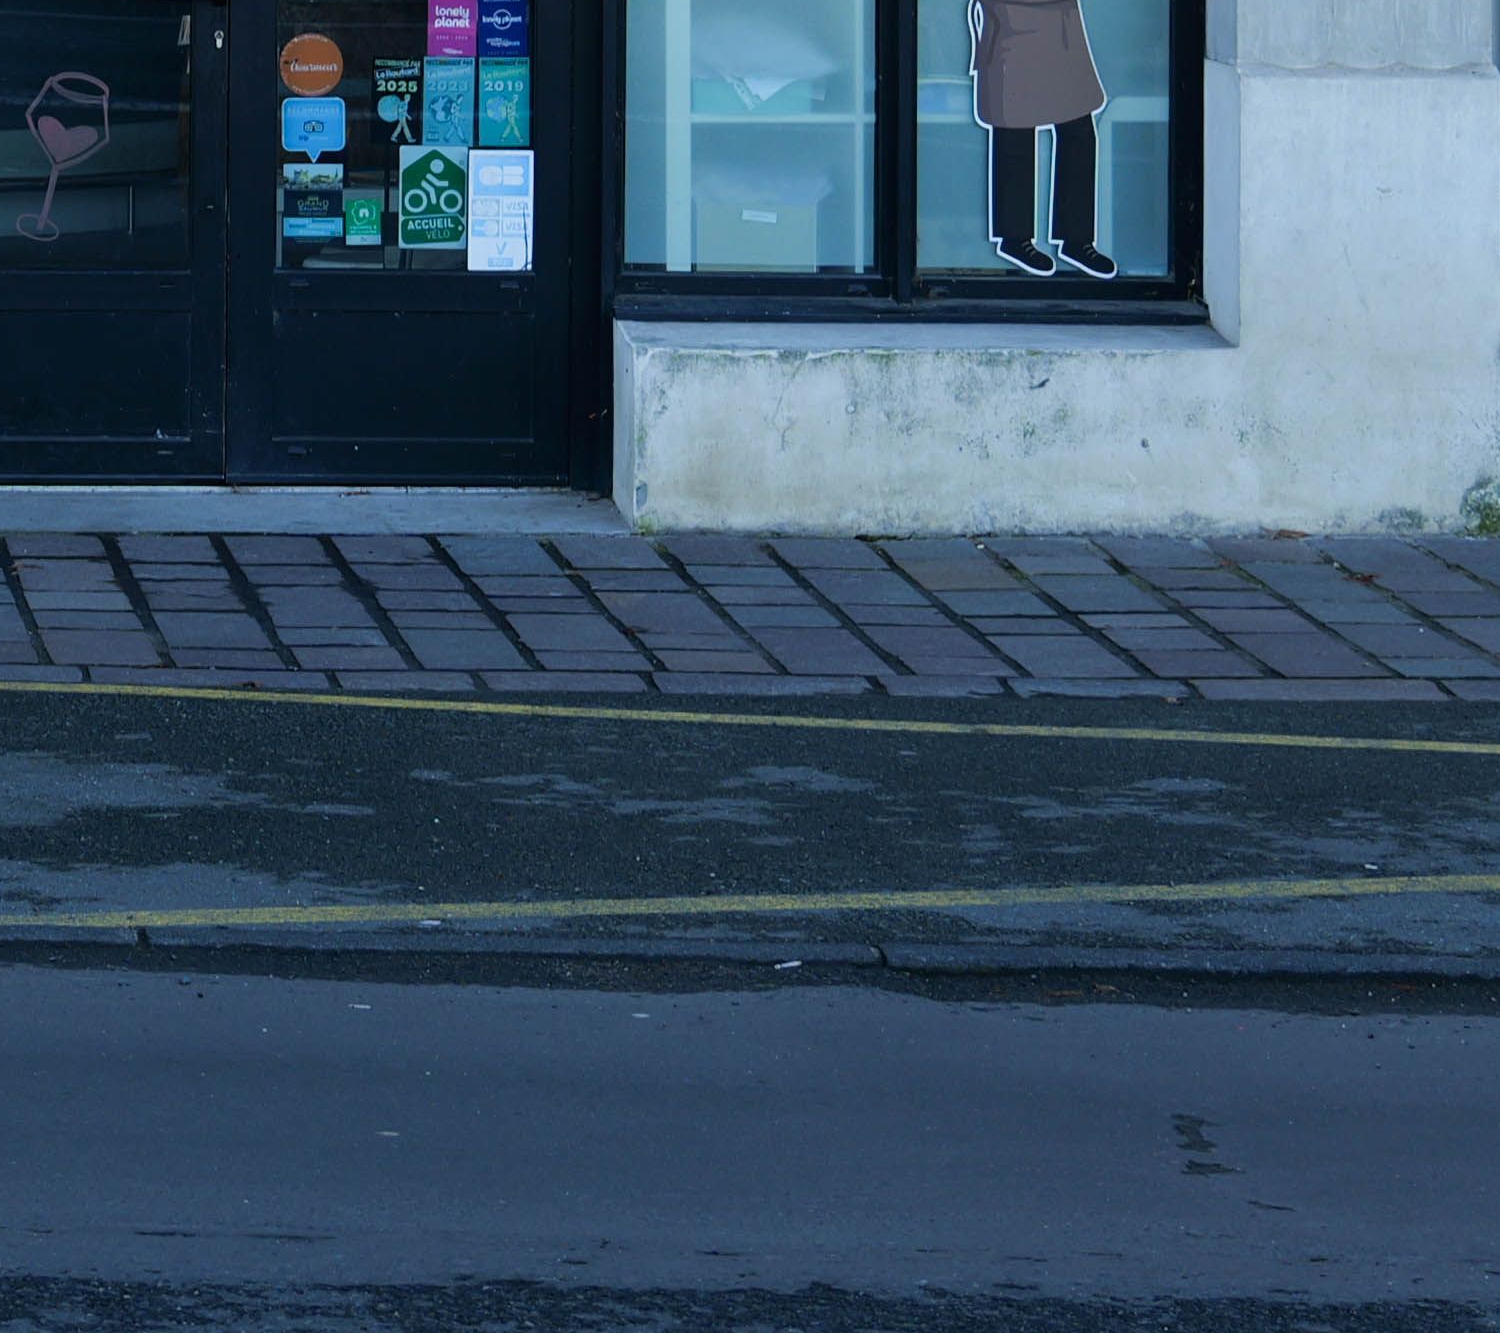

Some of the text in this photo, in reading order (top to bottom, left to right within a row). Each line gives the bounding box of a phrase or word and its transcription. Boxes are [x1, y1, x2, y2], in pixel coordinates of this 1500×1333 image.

[435, 4, 470, 19] lonely
[434, 16, 470, 29] planet
[376, 79, 418, 92] 2025
[484, 80, 524, 92] 2019
[407, 216, 455, 230] ACCUEIL
[425, 229, 450, 240] VÉLO
